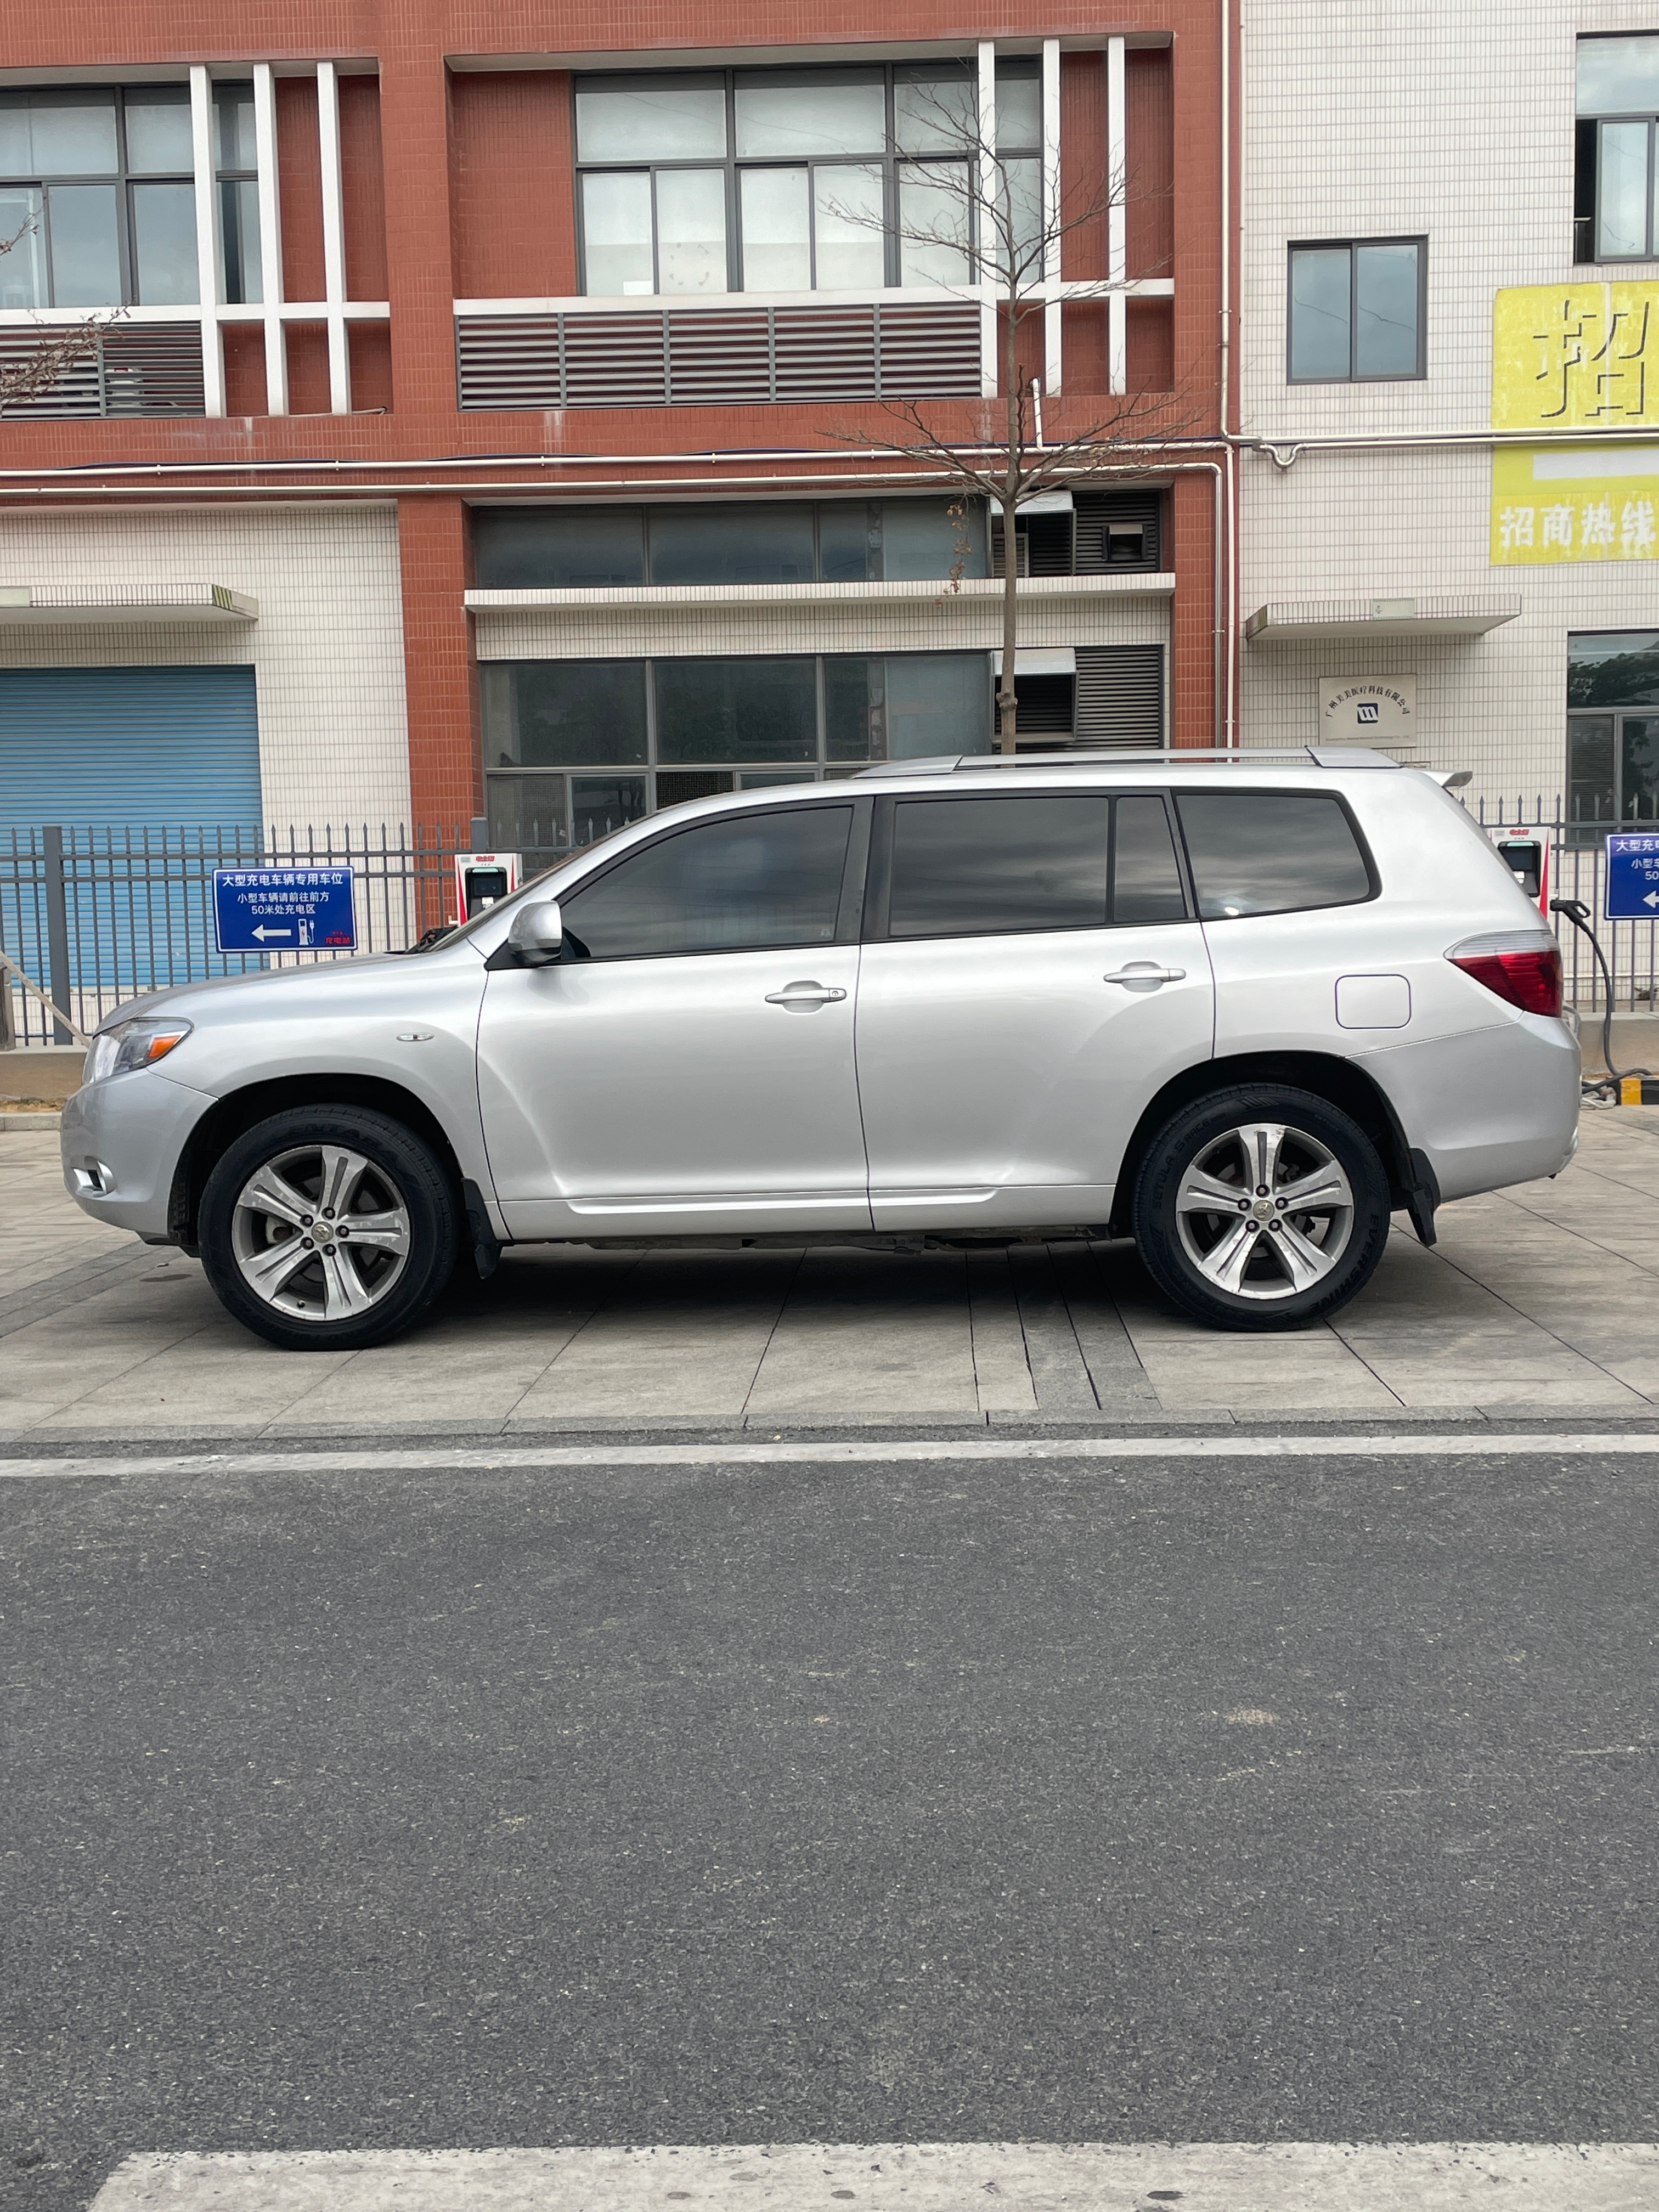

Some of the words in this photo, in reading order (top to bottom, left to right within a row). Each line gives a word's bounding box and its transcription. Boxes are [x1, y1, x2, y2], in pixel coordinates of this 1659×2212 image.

[1499, 500, 1656, 549] 招商热线
[222, 872, 343, 887] 大型充电车辆专用车位
[237, 891, 330, 904] 小型车辆请前往前方
[251, 904, 316, 915] 50米处充电区
